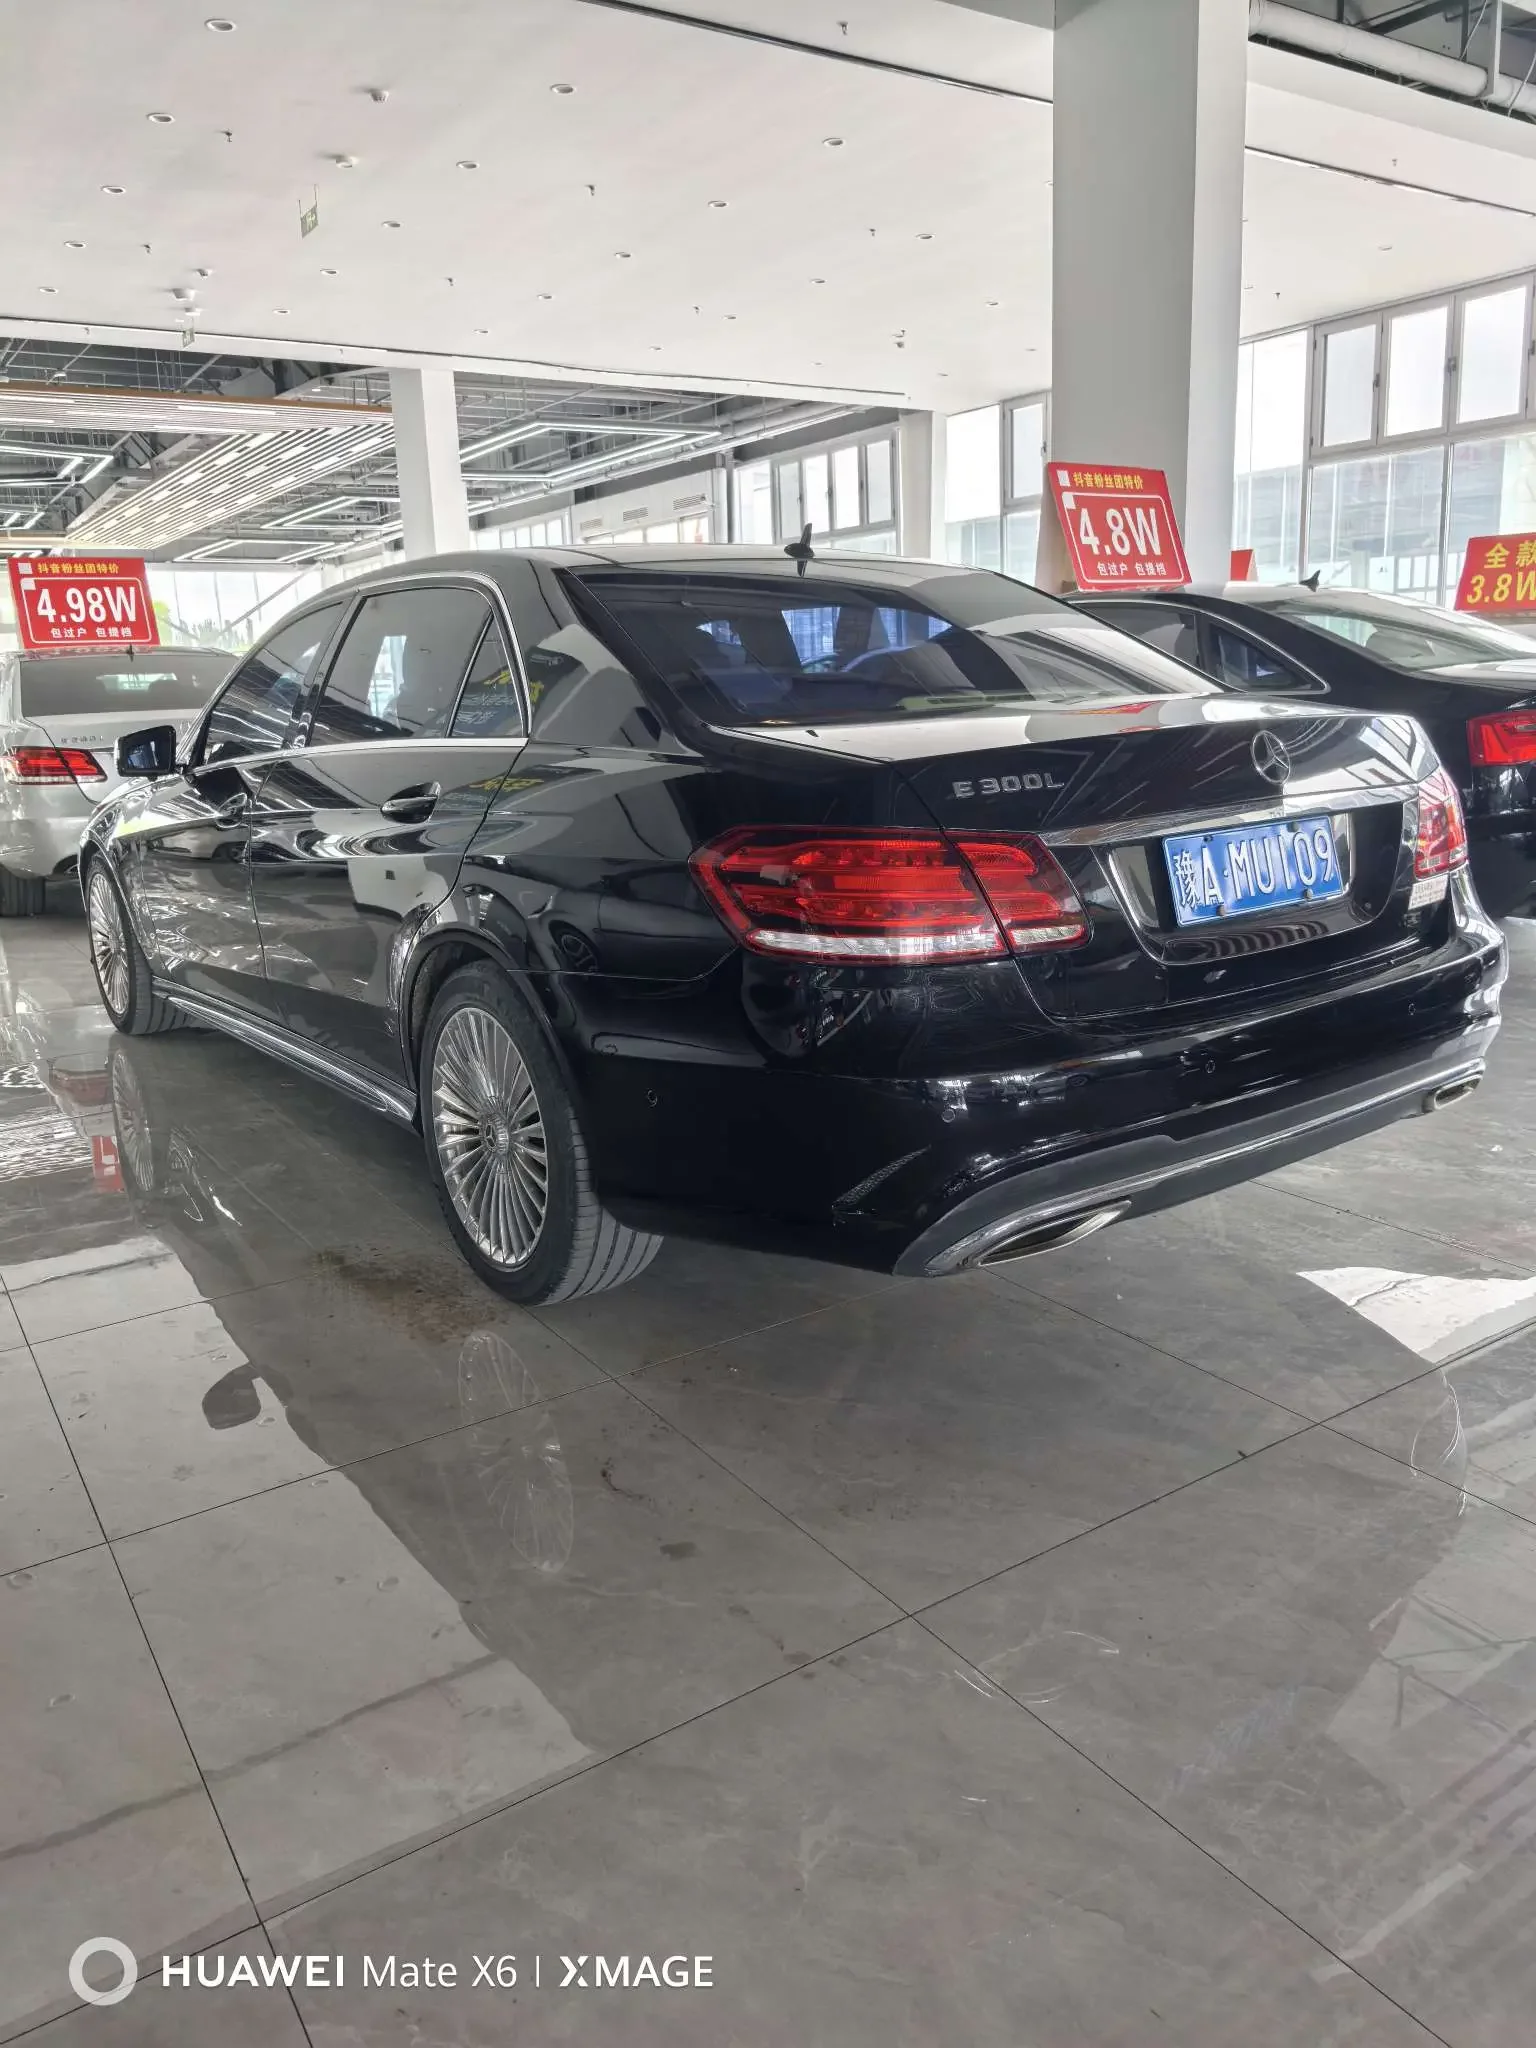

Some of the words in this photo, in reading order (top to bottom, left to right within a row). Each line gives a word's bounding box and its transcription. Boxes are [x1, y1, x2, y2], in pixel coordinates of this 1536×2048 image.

[1072, 471, 1143, 490] 抖音粉丝团特价
[1079, 507, 1163, 556] 4.8W
[37, 562, 120, 574] 抖音粉丝团特价
[1097, 561, 1128, 576] 包过户
[1134, 561, 1168, 576] 包提档
[36, 586, 137, 623] 4.98W
[50, 627, 87, 638] 包过户
